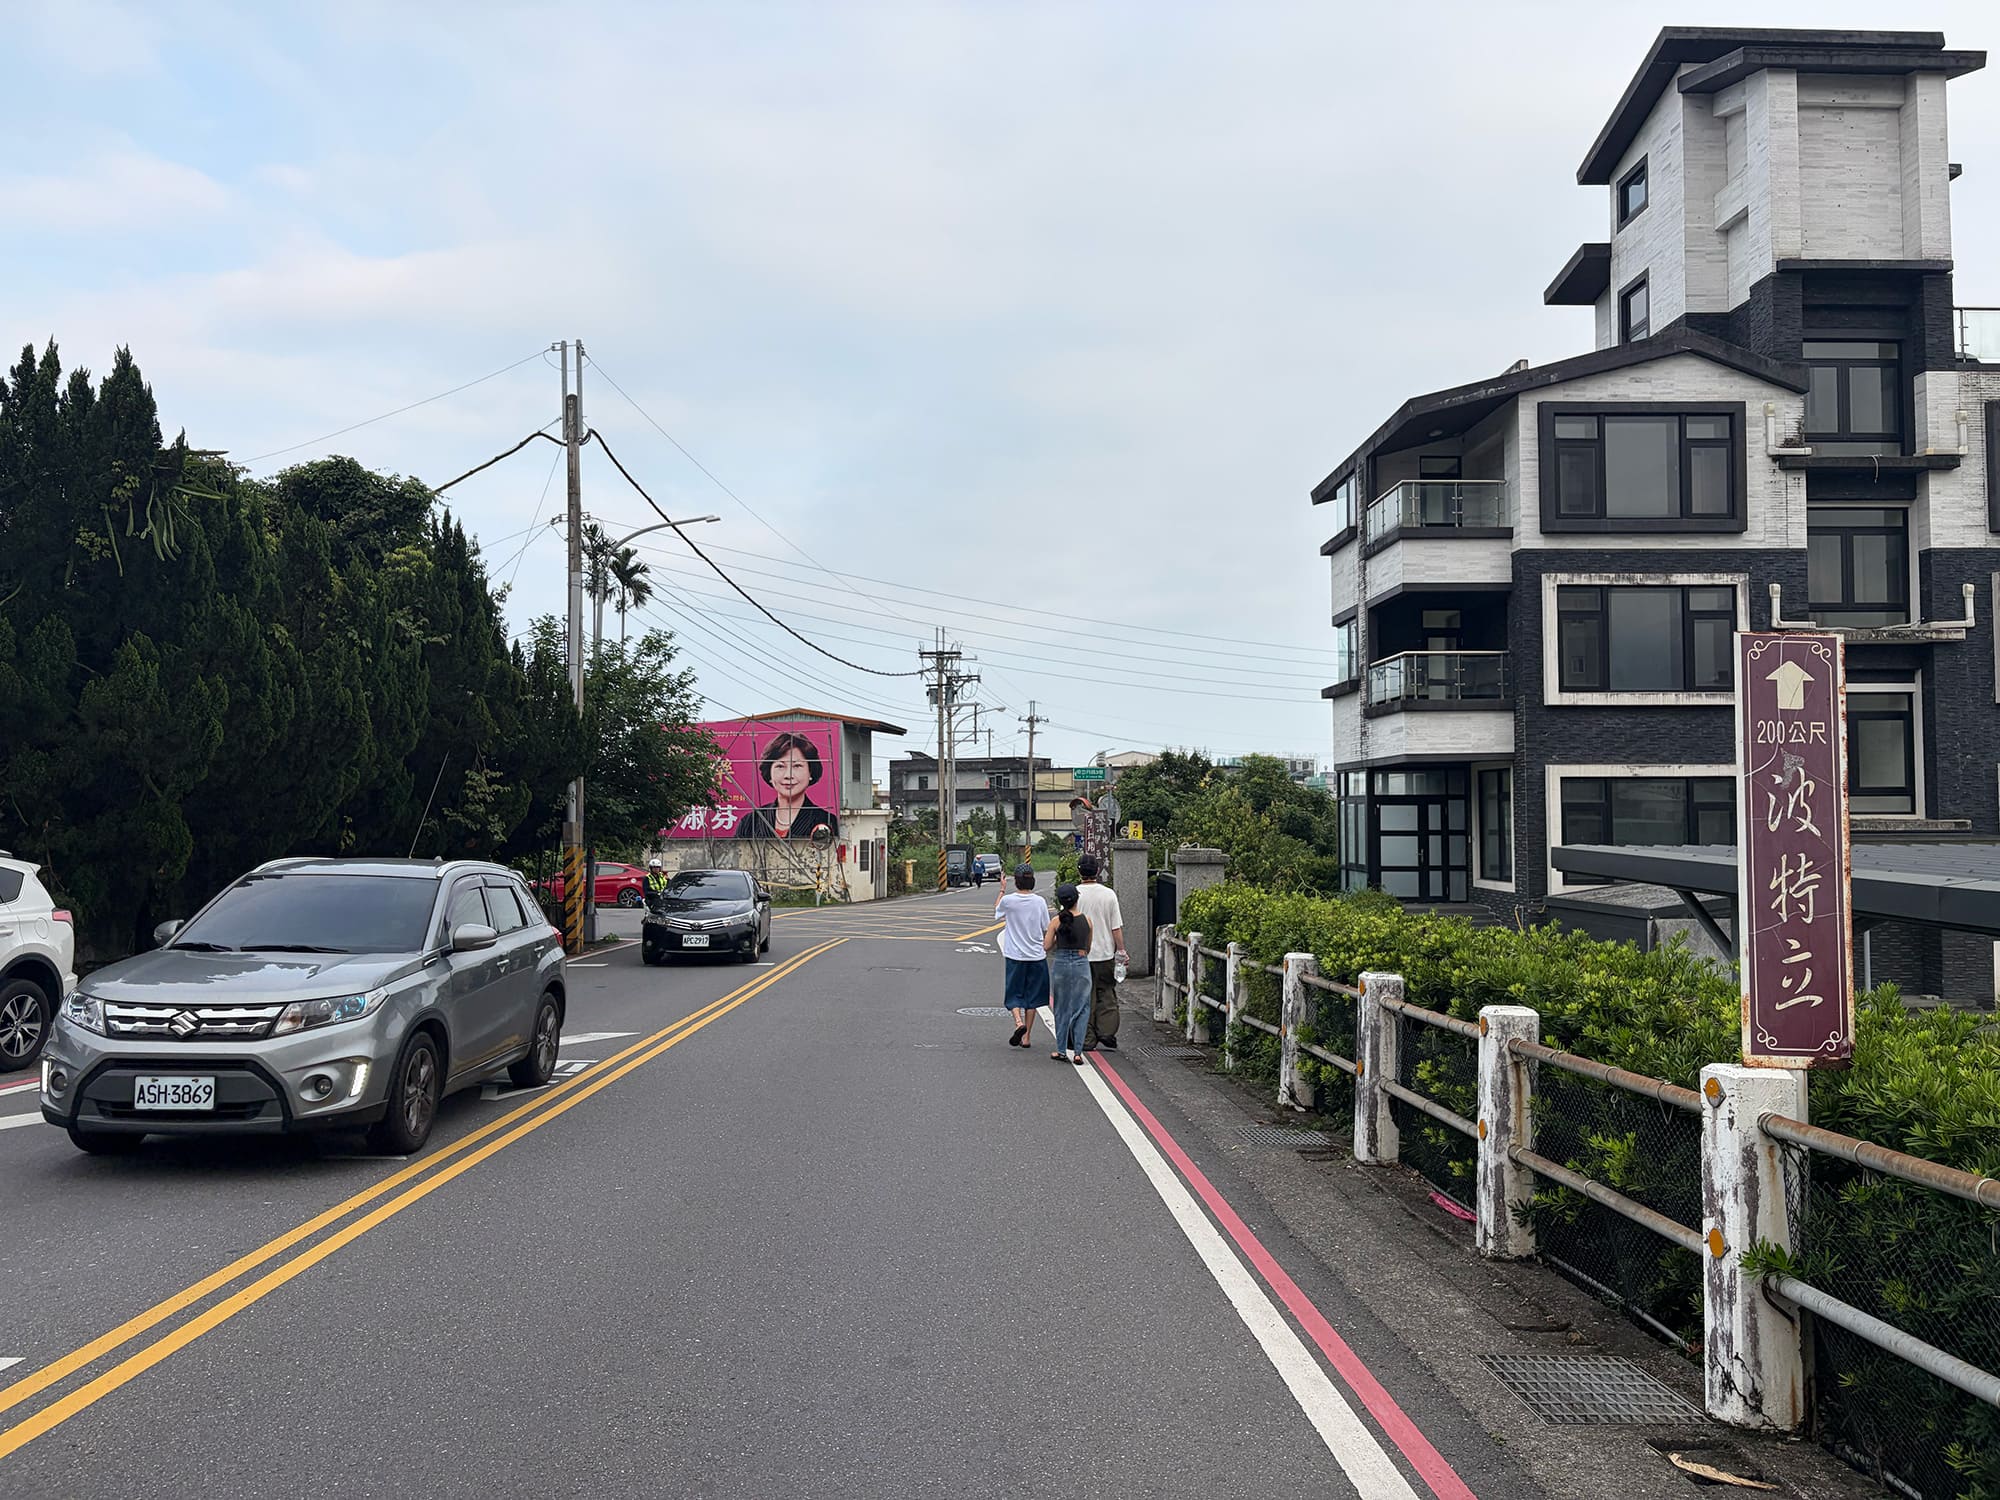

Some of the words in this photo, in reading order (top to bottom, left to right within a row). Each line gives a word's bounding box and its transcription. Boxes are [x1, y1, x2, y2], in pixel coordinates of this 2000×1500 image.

[1757, 720, 1827, 745] 200公尺
[1767, 766, 1823, 1011] 波特立
[136, 1084, 213, 1104] ASH-3869
